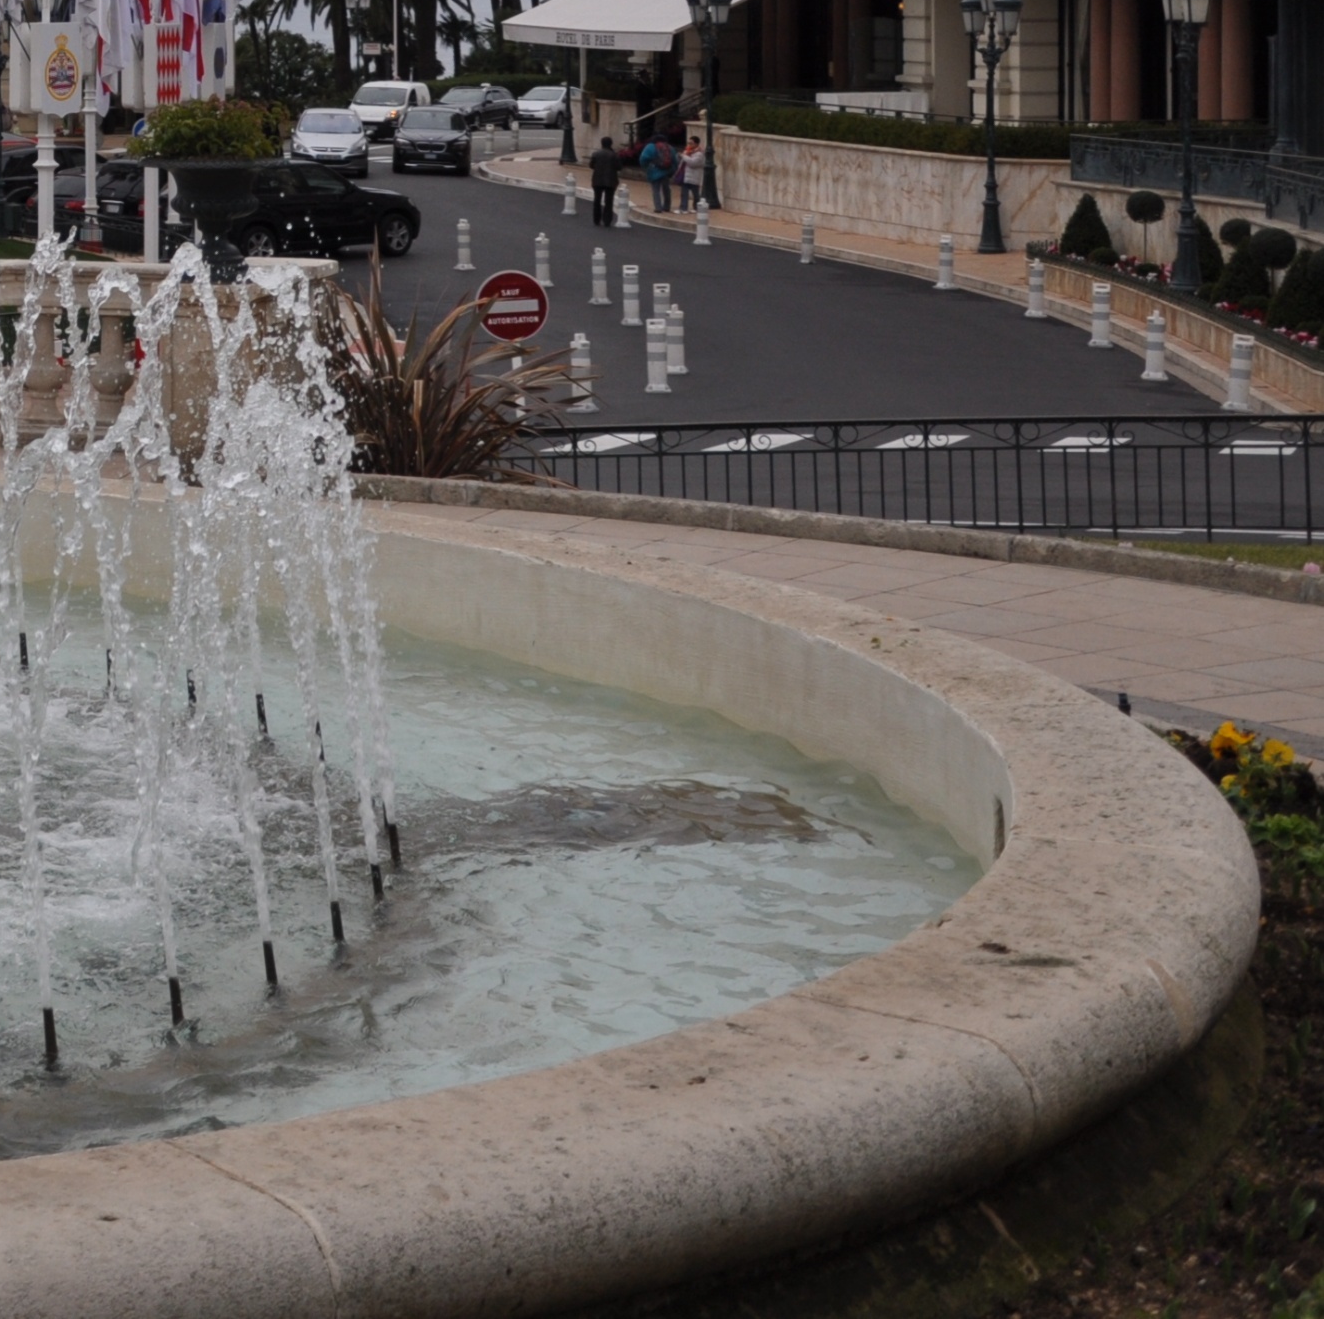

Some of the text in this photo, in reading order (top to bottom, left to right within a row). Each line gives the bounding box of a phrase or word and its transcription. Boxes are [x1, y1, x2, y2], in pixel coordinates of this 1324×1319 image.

[581, 33, 591, 46] DE
[594, 34, 615, 47] PARIS
[488, 316, 539, 325] AUTORISATION
